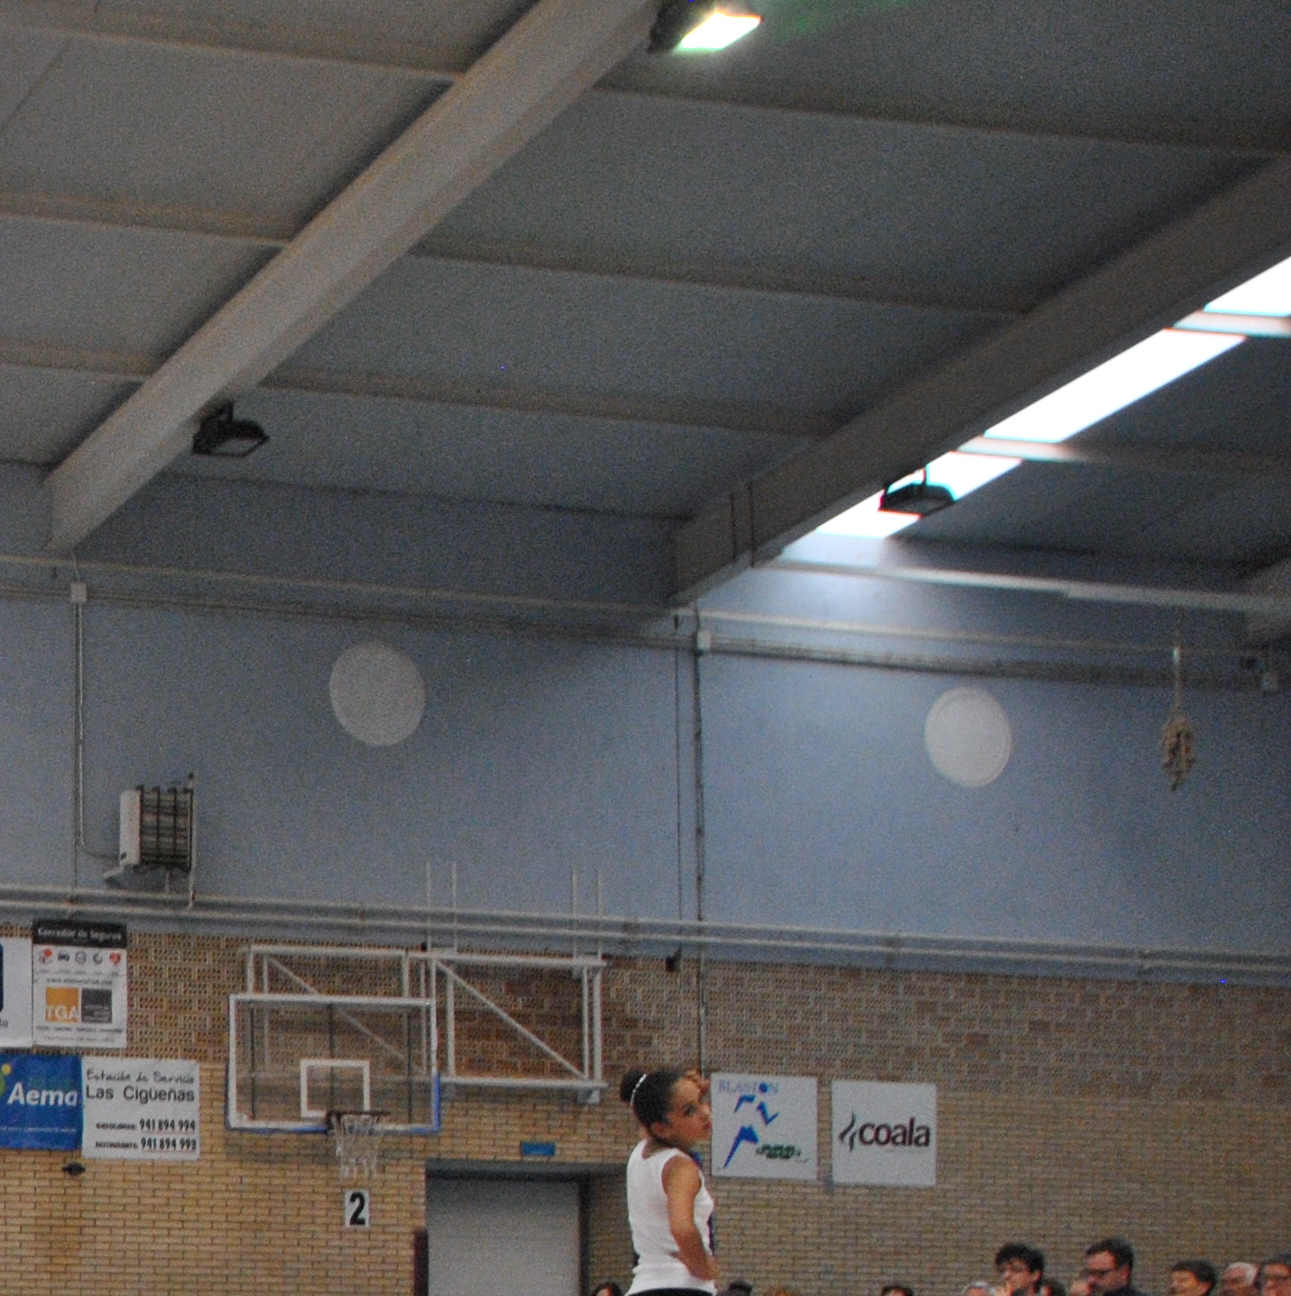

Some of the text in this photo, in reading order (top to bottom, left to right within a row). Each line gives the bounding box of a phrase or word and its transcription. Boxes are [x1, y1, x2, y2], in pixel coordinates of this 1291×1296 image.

[136, 1070, 149, 1083] de
[7, 1081, 78, 1107] Aema
[85, 1085, 195, 1105] Las Cigüeñas
[139, 1118, 156, 1131] 941
[158, 1119, 175, 1132] 894
[858, 1117, 930, 1147] coala
[140, 1137, 157, 1150] 941
[159, 1137, 177, 1151] 894
[348, 1191, 367, 1226] 2
